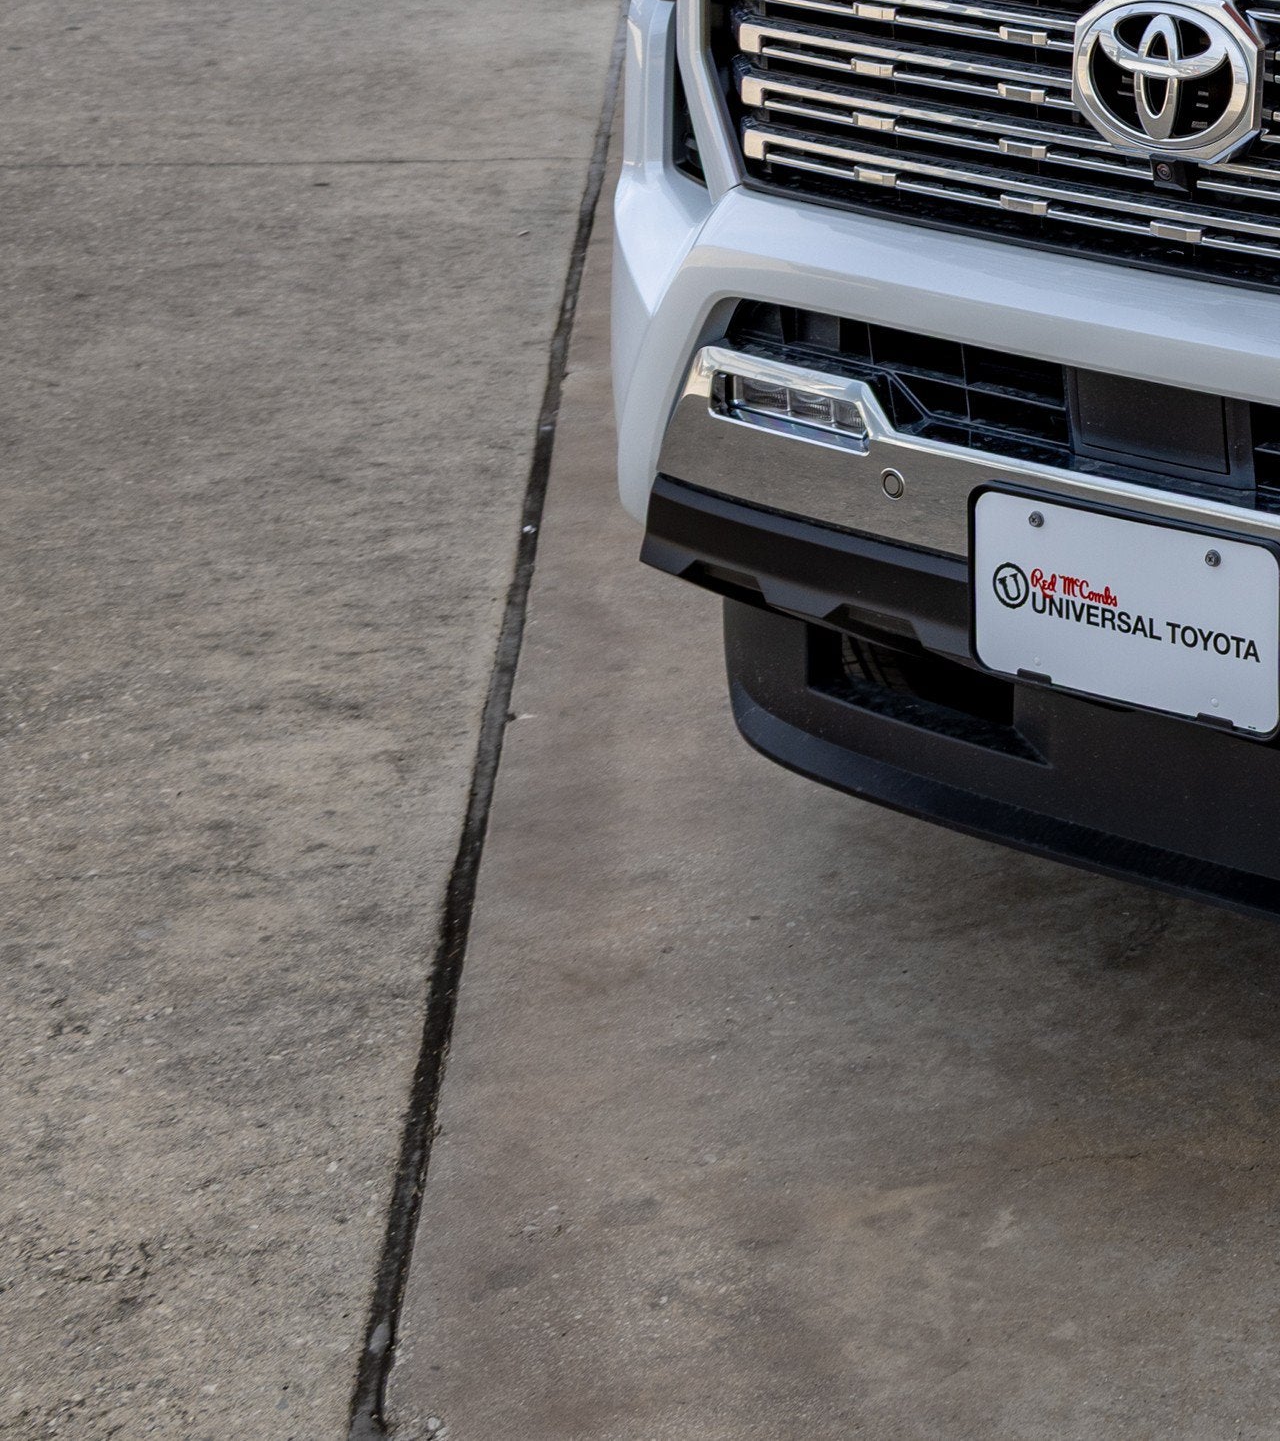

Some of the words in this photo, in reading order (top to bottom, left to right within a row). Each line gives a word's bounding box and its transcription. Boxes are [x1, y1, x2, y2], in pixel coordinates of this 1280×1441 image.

[1029, 568, 1057, 599] Red
[1058, 574, 1119, 608] McCombs
[1031, 591, 1163, 641] UNIVERSAL
[1165, 621, 1262, 664] TOYOTA
